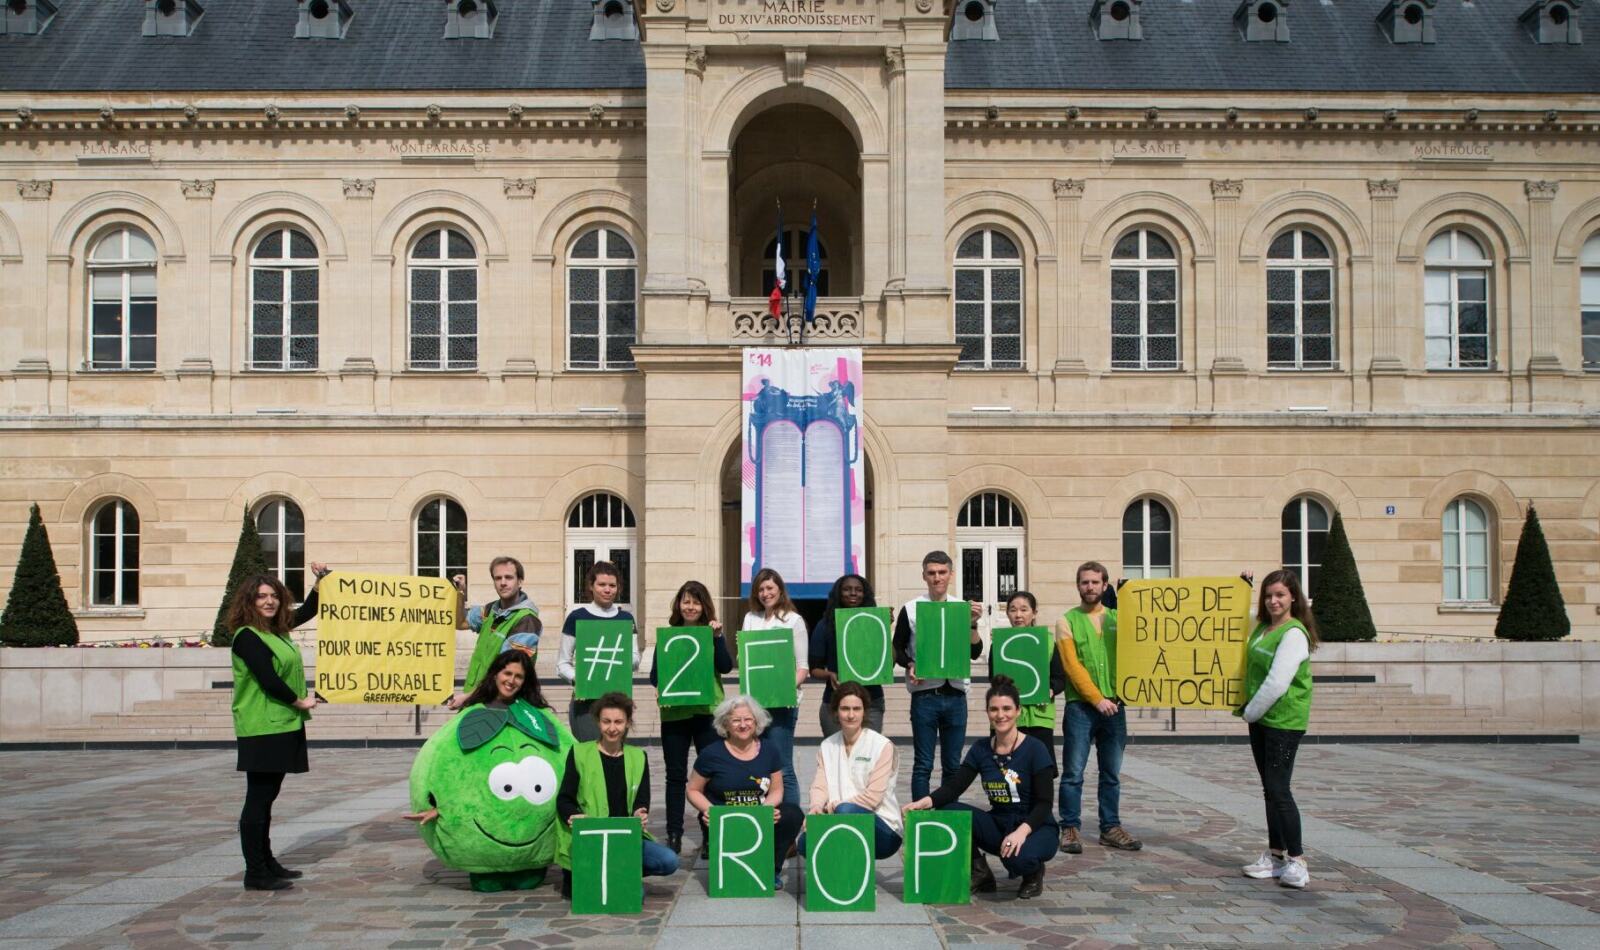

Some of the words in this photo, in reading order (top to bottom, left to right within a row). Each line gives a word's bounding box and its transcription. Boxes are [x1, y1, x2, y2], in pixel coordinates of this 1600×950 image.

[763, 0, 825, 13] MAIRIE
[719, 14, 736, 25] DU
[767, 14, 876, 25] ARRONDISSEMENT
[82, 144, 155, 154] PLAISANCE
[389, 143, 492, 153] MONTPARNASSE
[1414, 145, 1490, 156] MONTROUGE
[339, 578, 412, 598] MOINS
[419, 584, 446, 600] DE
[1131, 586, 1190, 614] TROP
[1202, 586, 1234, 612] DE
[320, 603, 395, 622] PROTEINES
[400, 607, 453, 626] ANIMALES
[1135, 616, 1244, 642] BIDOCHE
[318, 640, 351, 657] POUR
[355, 641, 381, 656] UNE
[386, 641, 447, 657] ASSIETTE
[1152, 646, 1170, 676] À
[1193, 648, 1223, 676] LA
[319, 672, 358, 691] PLUS
[367, 672, 443, 692] DURABLE
[363, 692, 418, 703] GREENPEACE
[1122, 676, 1244, 707] CANTOCHE
